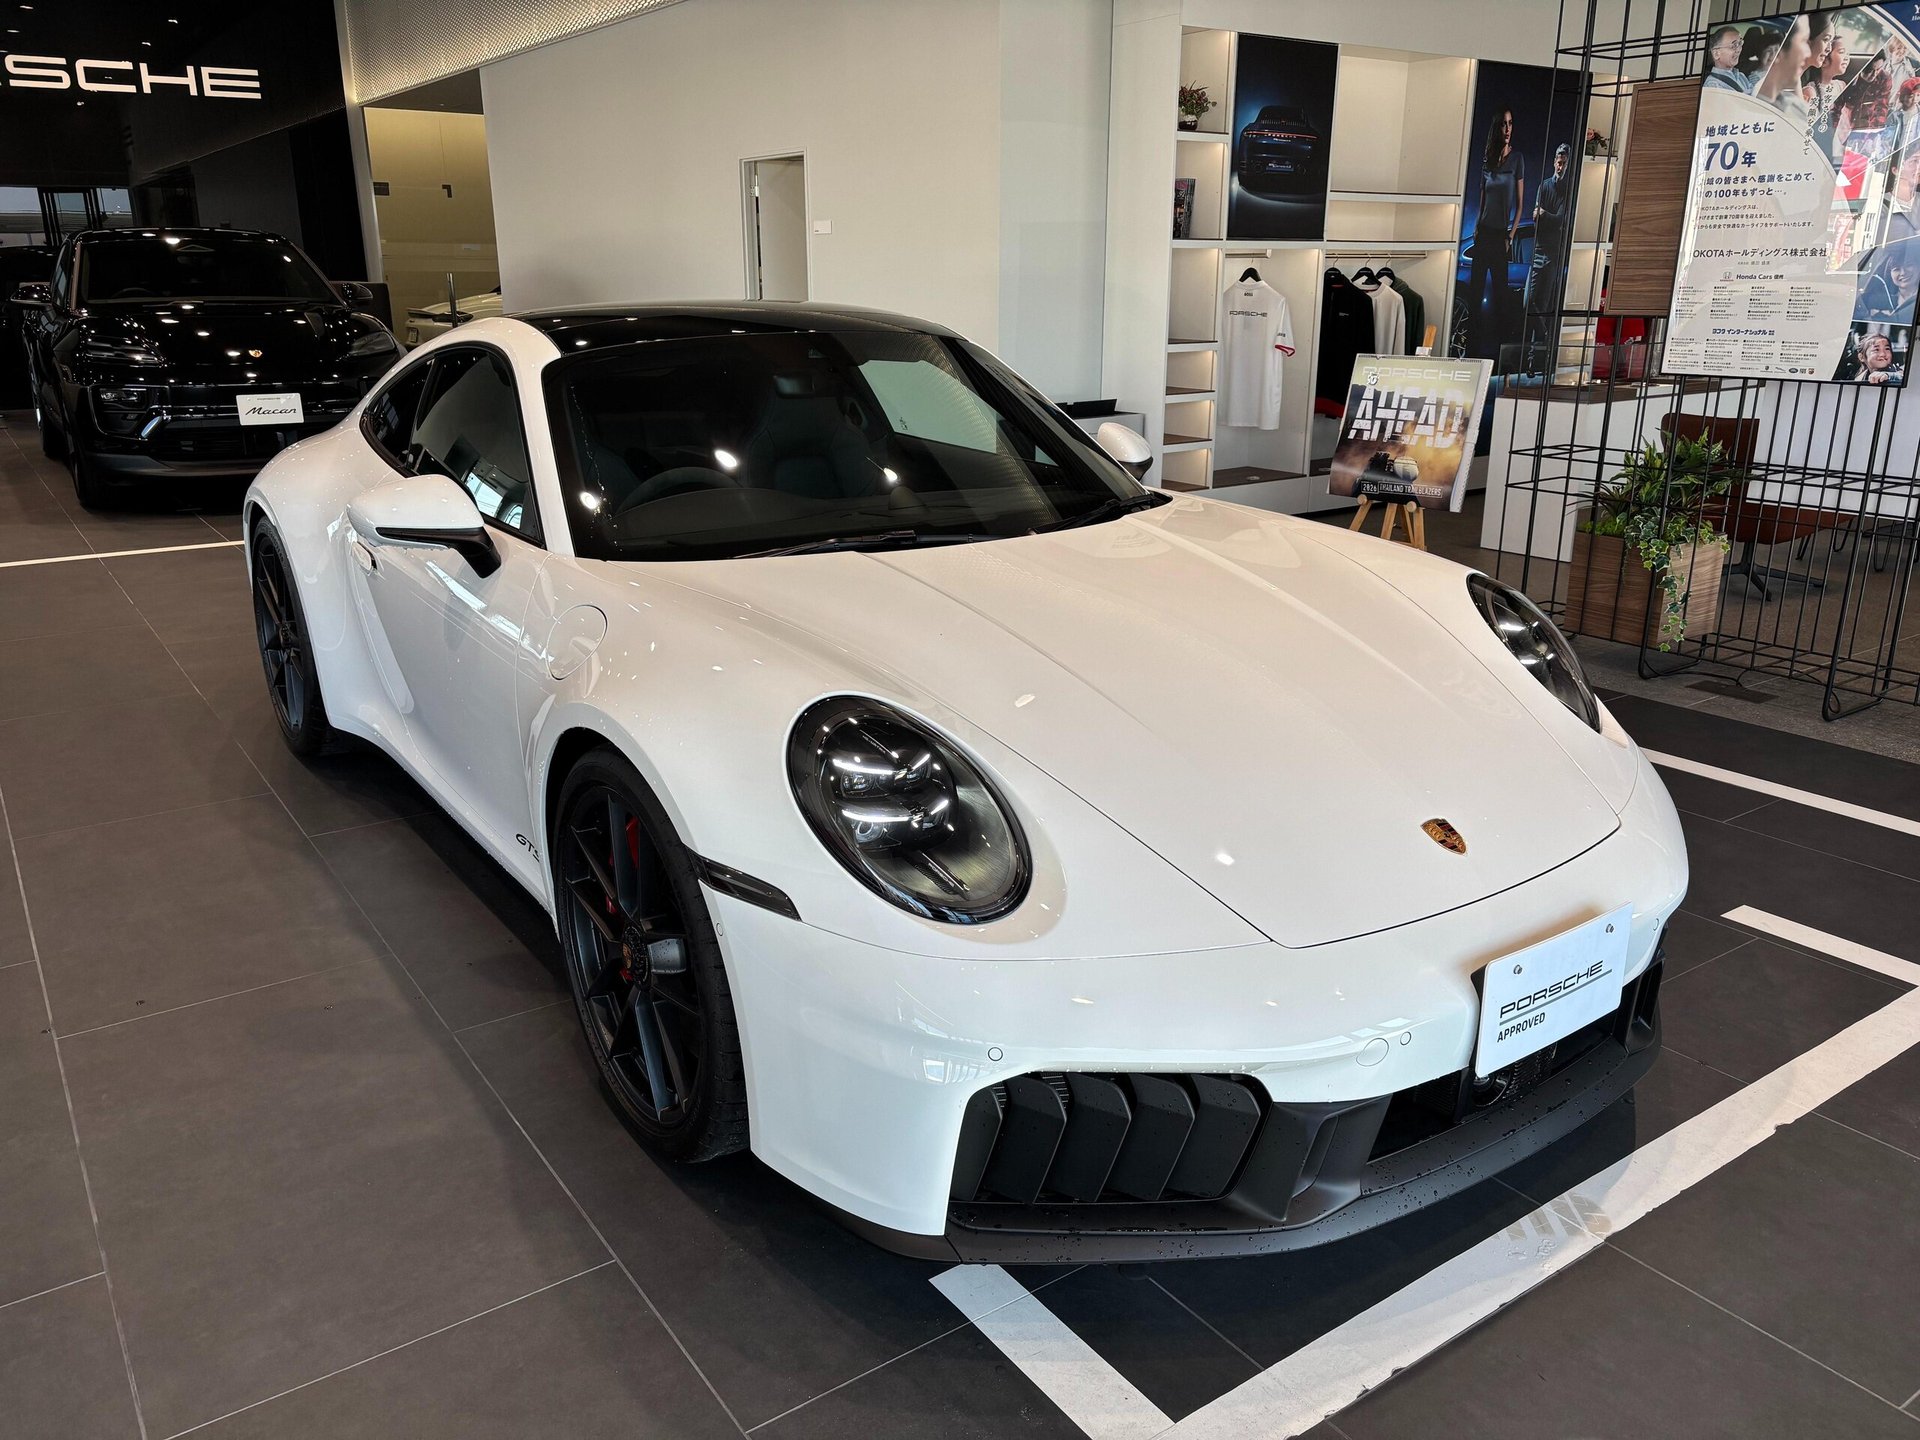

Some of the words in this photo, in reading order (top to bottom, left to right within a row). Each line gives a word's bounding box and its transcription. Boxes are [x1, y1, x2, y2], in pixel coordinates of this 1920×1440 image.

[0, 54, 262, 99] SCHE
[1705, 121, 1775, 137] 地域とともに
[1704, 140, 1757, 171] 70年
[1700, 172, 1816, 186] 域の皆さまへ感謝をこめて、
[1692, 247, 1827, 258] OKOTAホールディングス株式会社
[1362, 366, 1472, 382] PORSCHE
[245, 406, 297, 416] Macan
[1347, 385, 1464, 449] AHEAD
[1379, 483, 1404, 494] THAILAND
[1404, 484, 1442, 497] TRAILBLAZERS
[1500, 960, 1604, 1019] PORSCHE
[1497, 1012, 1546, 1043] APPROVED
